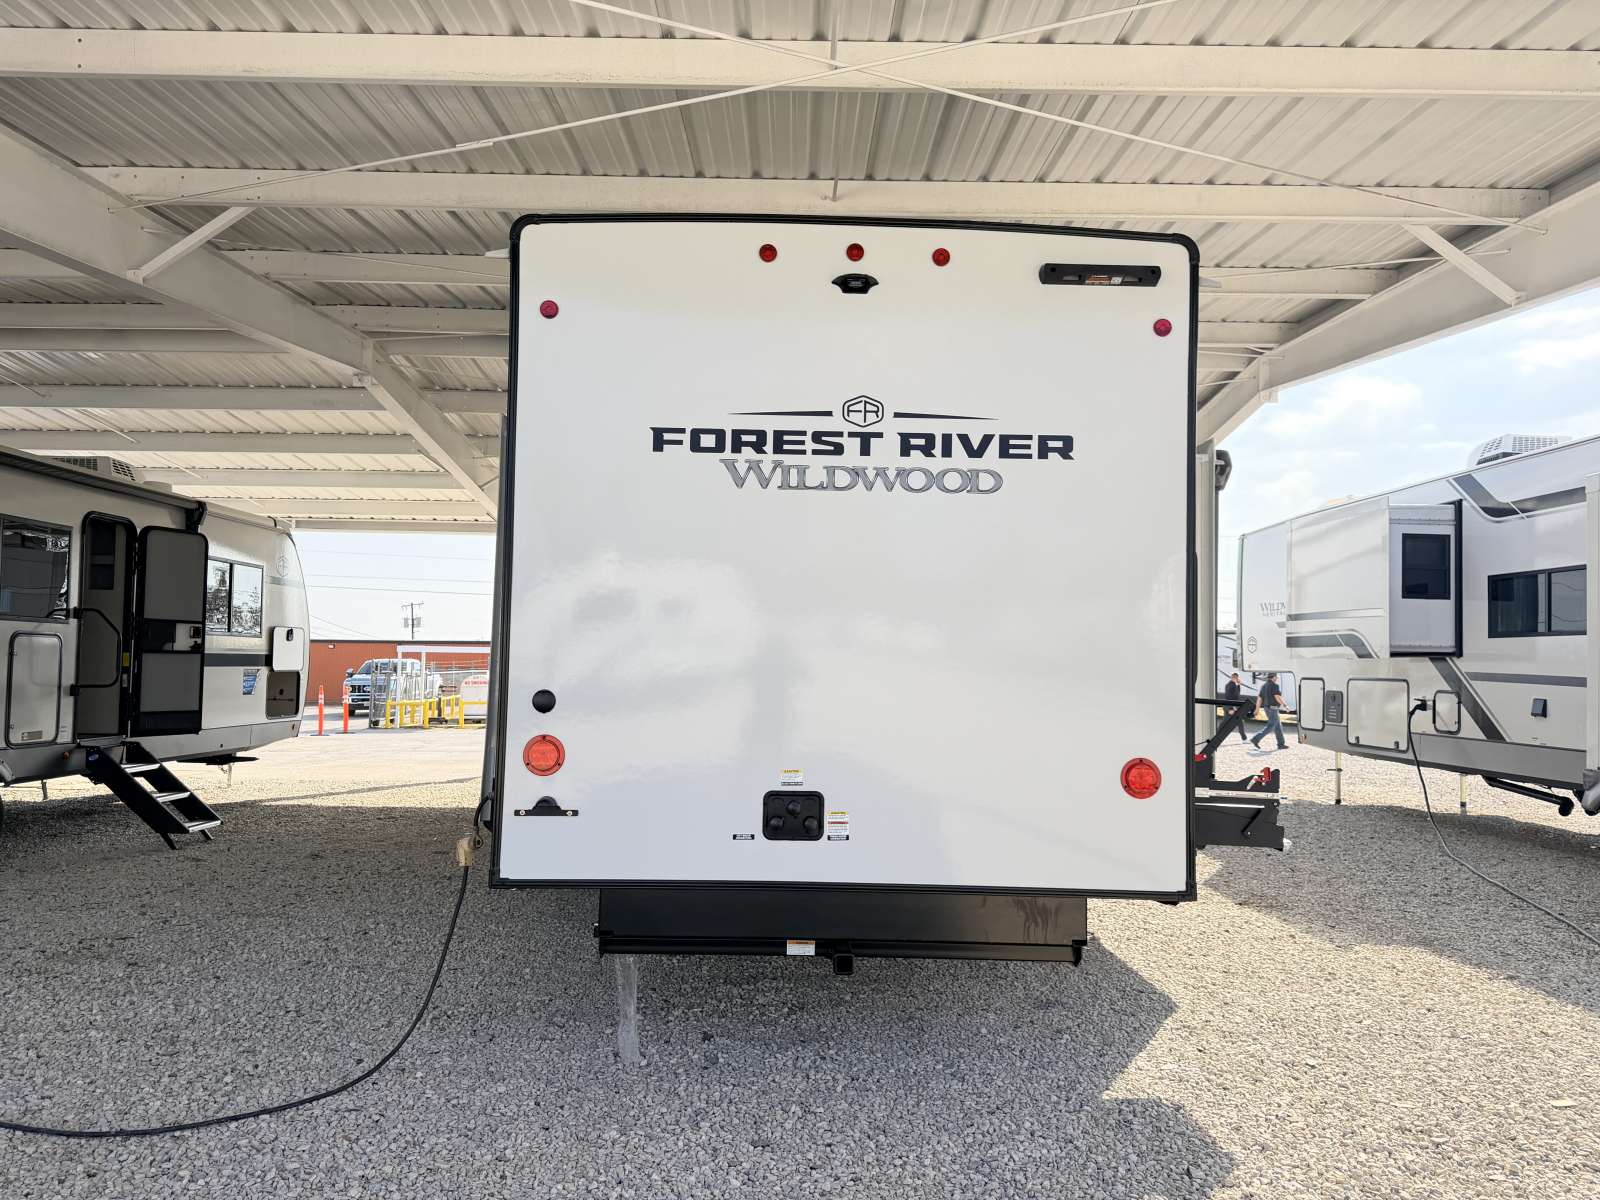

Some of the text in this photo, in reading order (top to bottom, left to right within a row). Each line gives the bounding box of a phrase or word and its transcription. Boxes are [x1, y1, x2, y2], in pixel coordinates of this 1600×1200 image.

[846, 399, 880, 423] FR
[649, 427, 1075, 460] FOREST RIVER
[719, 458, 1004, 494] WILDWOOD
